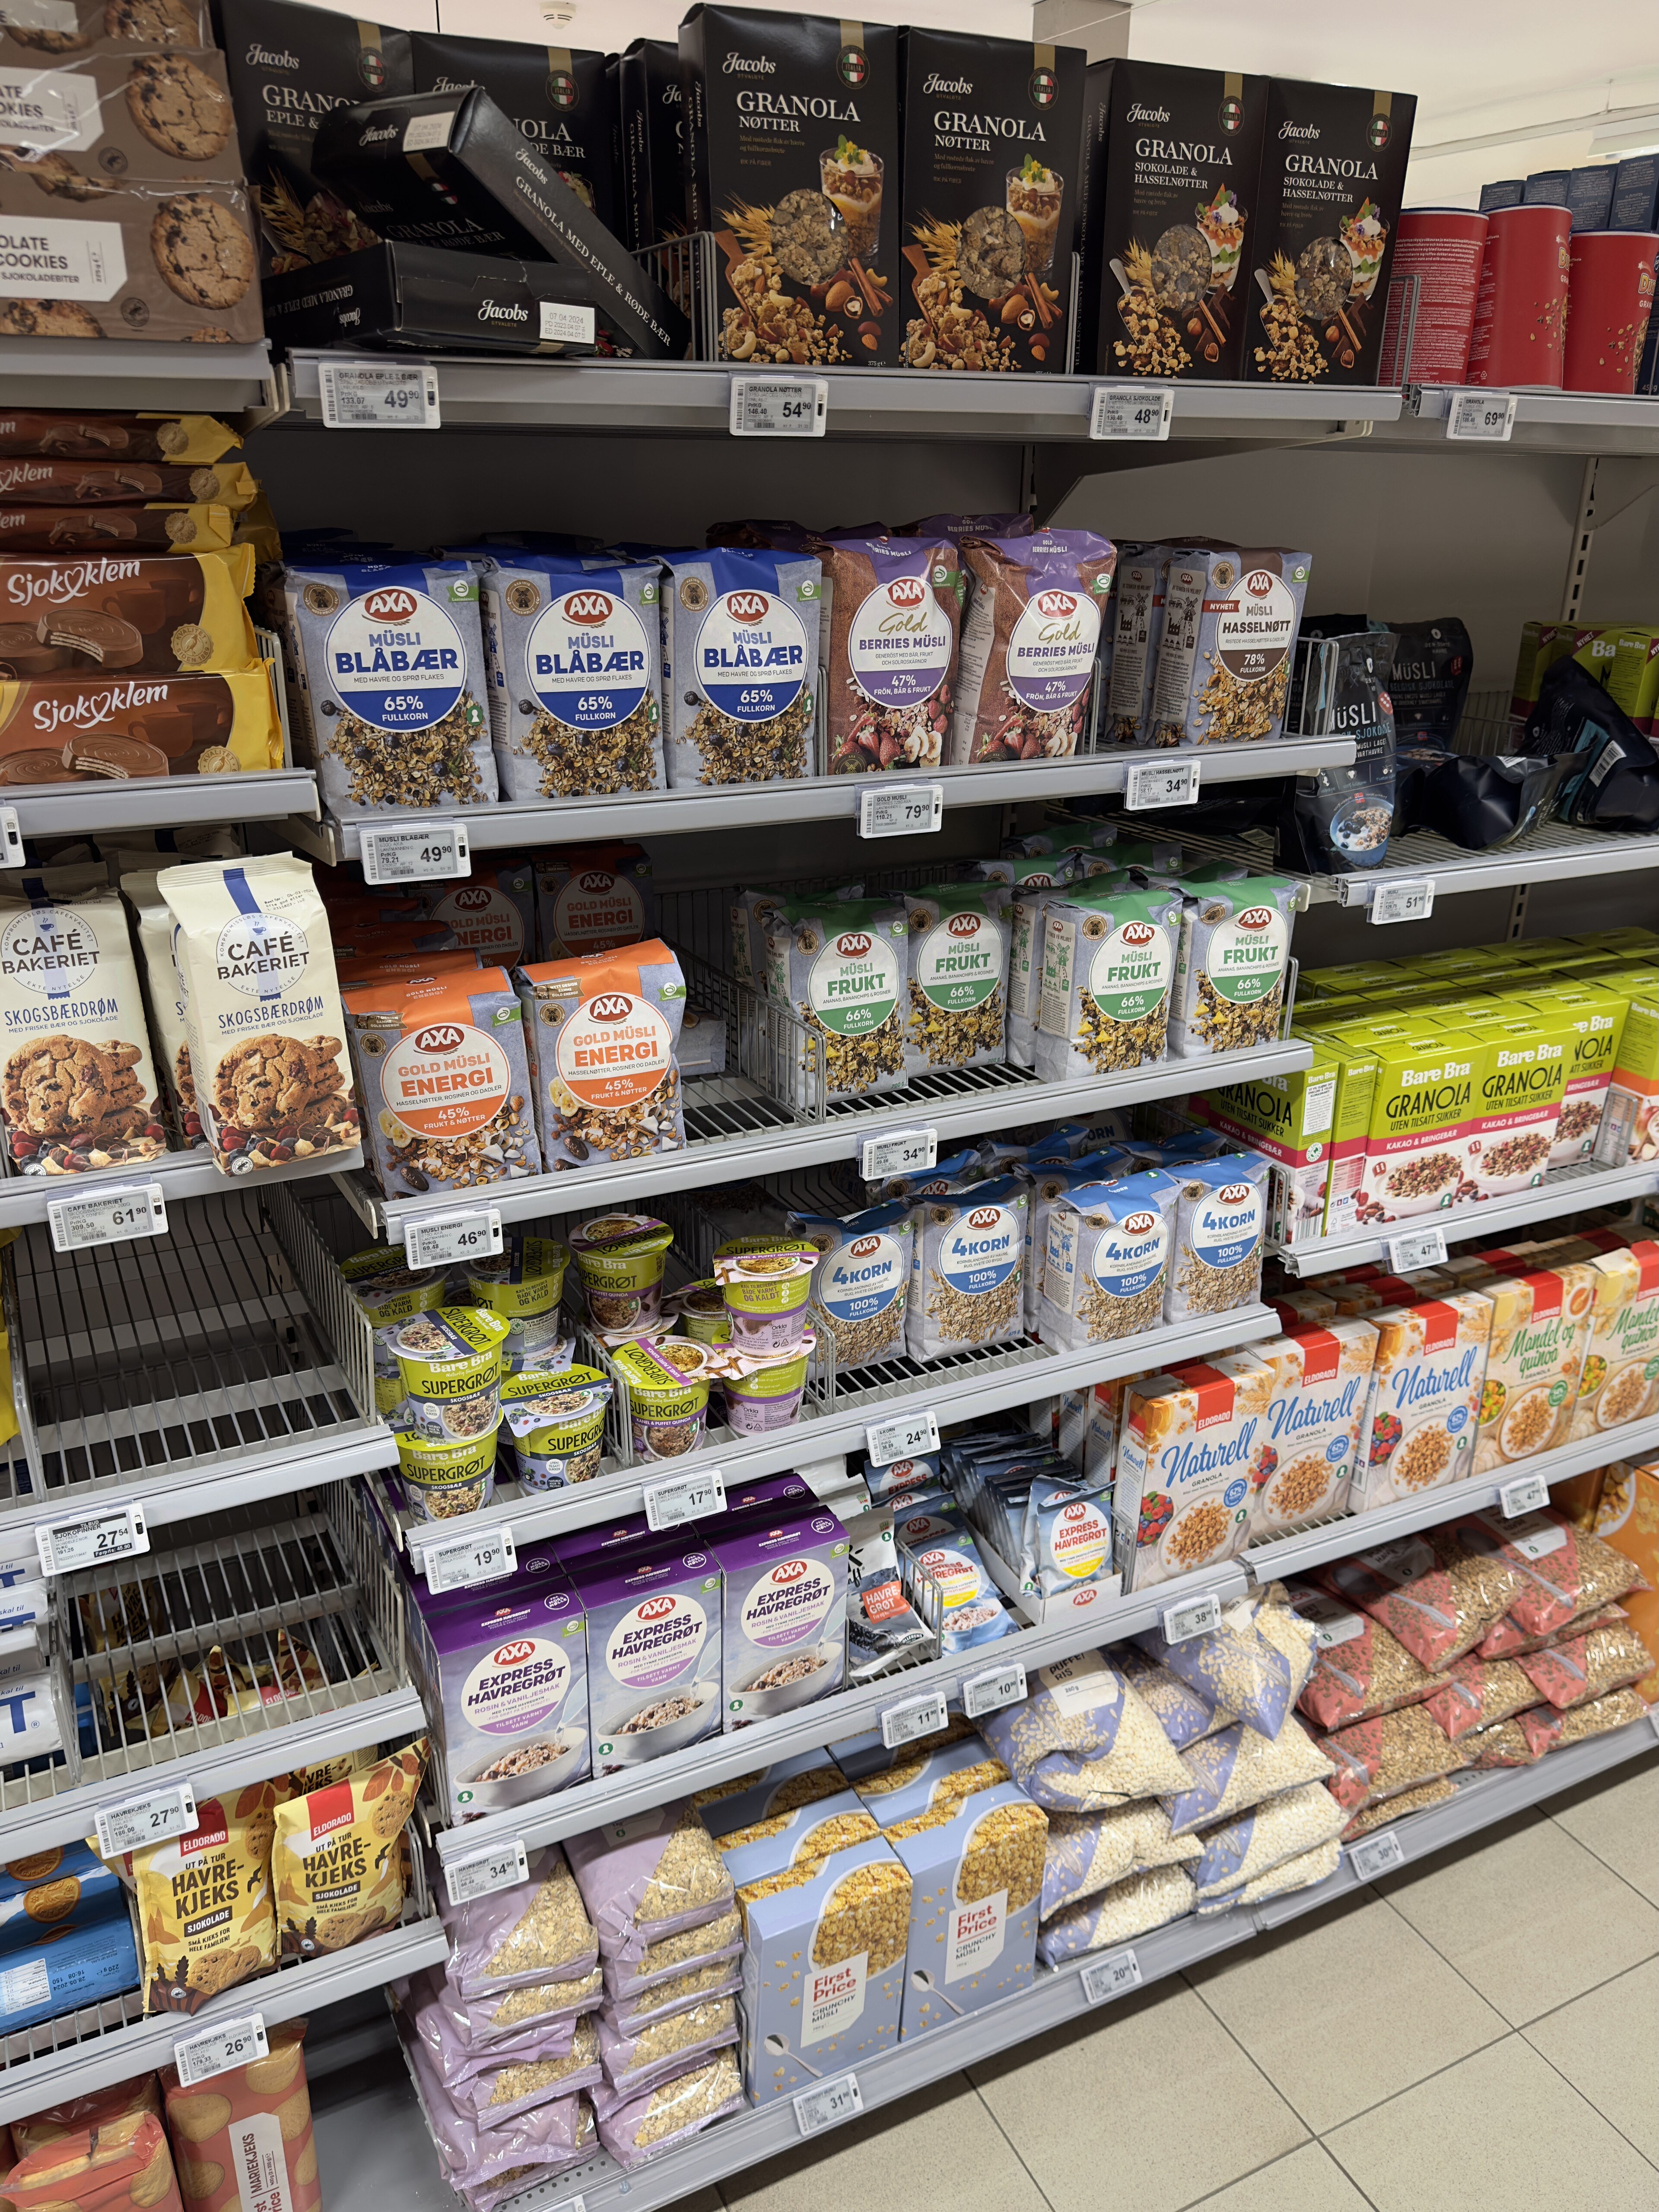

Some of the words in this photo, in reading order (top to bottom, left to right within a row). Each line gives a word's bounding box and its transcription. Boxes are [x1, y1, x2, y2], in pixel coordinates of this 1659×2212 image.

[245, 44, 299, 69] Jacobs
[723, 52, 776, 74] Jacobs
[736, 91, 861, 122] GRANOLA
[267, 110, 304, 127] EPLE
[308, 119, 319, 129] &
[739, 116, 801, 133] NØTTER
[934, 111, 1046, 142] GRANOLA
[934, 135, 991, 152] NØTTER
[1135, 138, 1233, 166] GRANOLA
[1135, 162, 1189, 175] SJOKOLADE
[1191, 167, 1198, 176] &
[1135, 174, 1208, 189] HASSELNØTTER
[515, 176, 564, 233] GRANOLA
[566, 229, 589, 257] MED
[589, 255, 615, 286] EPLE
[616, 283, 623, 295] &
[624, 291, 649, 323] RØDE
[650, 319, 671, 346] BÆR
[2, 273, 79, 283] SJOKOLADEBITER
[385, 390, 408, 408] 49
[782, 401, 802, 419] 54
[1135, 408, 1151, 424] 48
[1484, 412, 1498, 426] 69
[369, 592, 413, 613] AXA
[1246, 604, 1273, 617] MÜSLI
[878, 612, 928, 634] Gold
[1223, 620, 1291, 634] HASSELNØTT
[369, 630, 421, 647] MÜSLI
[859, 638, 910, 650] BERRIES
[912, 634, 946, 648] MÜSLI
[335, 647, 459, 674] BLÅBÆR
[536, 650, 645, 675] BLÅBÆR
[704, 645, 803, 668] BLÅBÆR
[1244, 654, 1265, 665] 78%
[891, 675, 916, 686] 47%
[384, 696, 423, 711] 65%
[381, 712, 428, 721] FULLKORN
[1166, 780, 1180, 793] 34
[906, 805, 921, 819] 79
[420, 847, 441, 862] 49
[228, 932, 295, 960] CAFÉ
[217, 952, 309, 980] BAKERIET
[241, 985, 259, 993] EKTE
[264, 976, 296, 994] NYTELSE
[827, 973, 886, 996] FRUKT
[5, 998, 118, 1025] SKOGSBÆRDRØM
[218, 996, 324, 1029] SKOGSBÆRDRØM
[846, 1008, 872, 1021] 66%
[237, 1025, 258, 1033] FRISKE
[288, 1011, 324, 1025] SJOKOLADE
[398, 1062, 444, 1077] GOLD
[447, 1052, 491, 1071] MÜSLI
[400, 1068, 493, 1097] ENERGI
[1402, 1068, 1441, 1087] Bare
[1444, 1062, 1471, 1078] Bra
[591, 1091, 614, 1100] FRUKT
[622, 1086, 647, 1096] NØTTER
[1386, 1081, 1471, 1118] GRANOLA
[1386, 1138, 1411, 1150] KAKAO
[1413, 1137, 1420, 1146] &
[1422, 1129, 1458, 1144] BRINGEBÆR
[903, 1149, 918, 1160] 34
[88, 1198, 123, 1208] BAKERIET
[71, 1222, 94, 1231] 309.50
[113, 1209, 135, 1225] 61
[441, 1223, 463, 1231] ENERGI
[458, 1231, 477, 1246] 46
[726, 1243, 806, 1254] SUPERGRØT
[833, 1260, 892, 1285] 4KORN
[849, 1298, 878, 1311] 100%
[1502, 1317, 1559, 1364] Mandel
[1561, 1324, 1575, 1348] og
[429, 1361, 468, 1373] Bare
[471, 1351, 493, 1364] Bra
[1519, 1348, 1558, 1379] quinoa
[421, 1362, 499, 1395] SUPERGRØT
[450, 1392, 480, 1403] SKOGSBÆR
[629, 1396, 698, 1417] SUPERGRØT
[1198, 1411, 1230, 1430] ELDORADO
[907, 1431, 921, 1445] 24
[1161, 1417, 1257, 1488] Naturell
[689, 1491, 703, 1505] 17
[54, 1524, 101, 1539] SJOKOPINNER
[97, 1530, 118, 1549] 27
[119, 1528, 128, 1536] 54
[439, 1544, 472, 1557] SUPERGRØT
[474, 1550, 492, 1567] 19
[757, 1578, 821, 1606] EXPRESS
[866, 1586, 900, 1605] HAVRE-
[746, 1585, 831, 1621] HAVREGRØT
[869, 1599, 895, 1615] GRØT
[479, 1658, 553, 1691] EXPRESS
[1054, 1669, 1073, 1681] RIS
[467, 1666, 566, 1707] HAVREGRØT
[506, 1683, 560, 1707] VANILJESMAK
[111, 1803, 152, 1819] HAVREKJEKS
[150, 1809, 169, 1828] 27
[183, 1831, 226, 1851] ELDORADO
[185, 1861, 196, 1870] UT
[198, 1857, 210, 1866] PÅ
[211, 1853, 226, 1862] TUR
[172, 1858, 245, 1896] HAVRE-
[175, 1880, 239, 1919] KJEKS
[187, 1909, 230, 1933] SJOKOLADE
[814, 1967, 852, 1991] First
[813, 1978, 856, 2002] Price
[812, 1993, 856, 2017] CRUNCHY
[225, 2039, 244, 2056] 26
[243, 2133, 256, 2192] MARIEKJEKS
